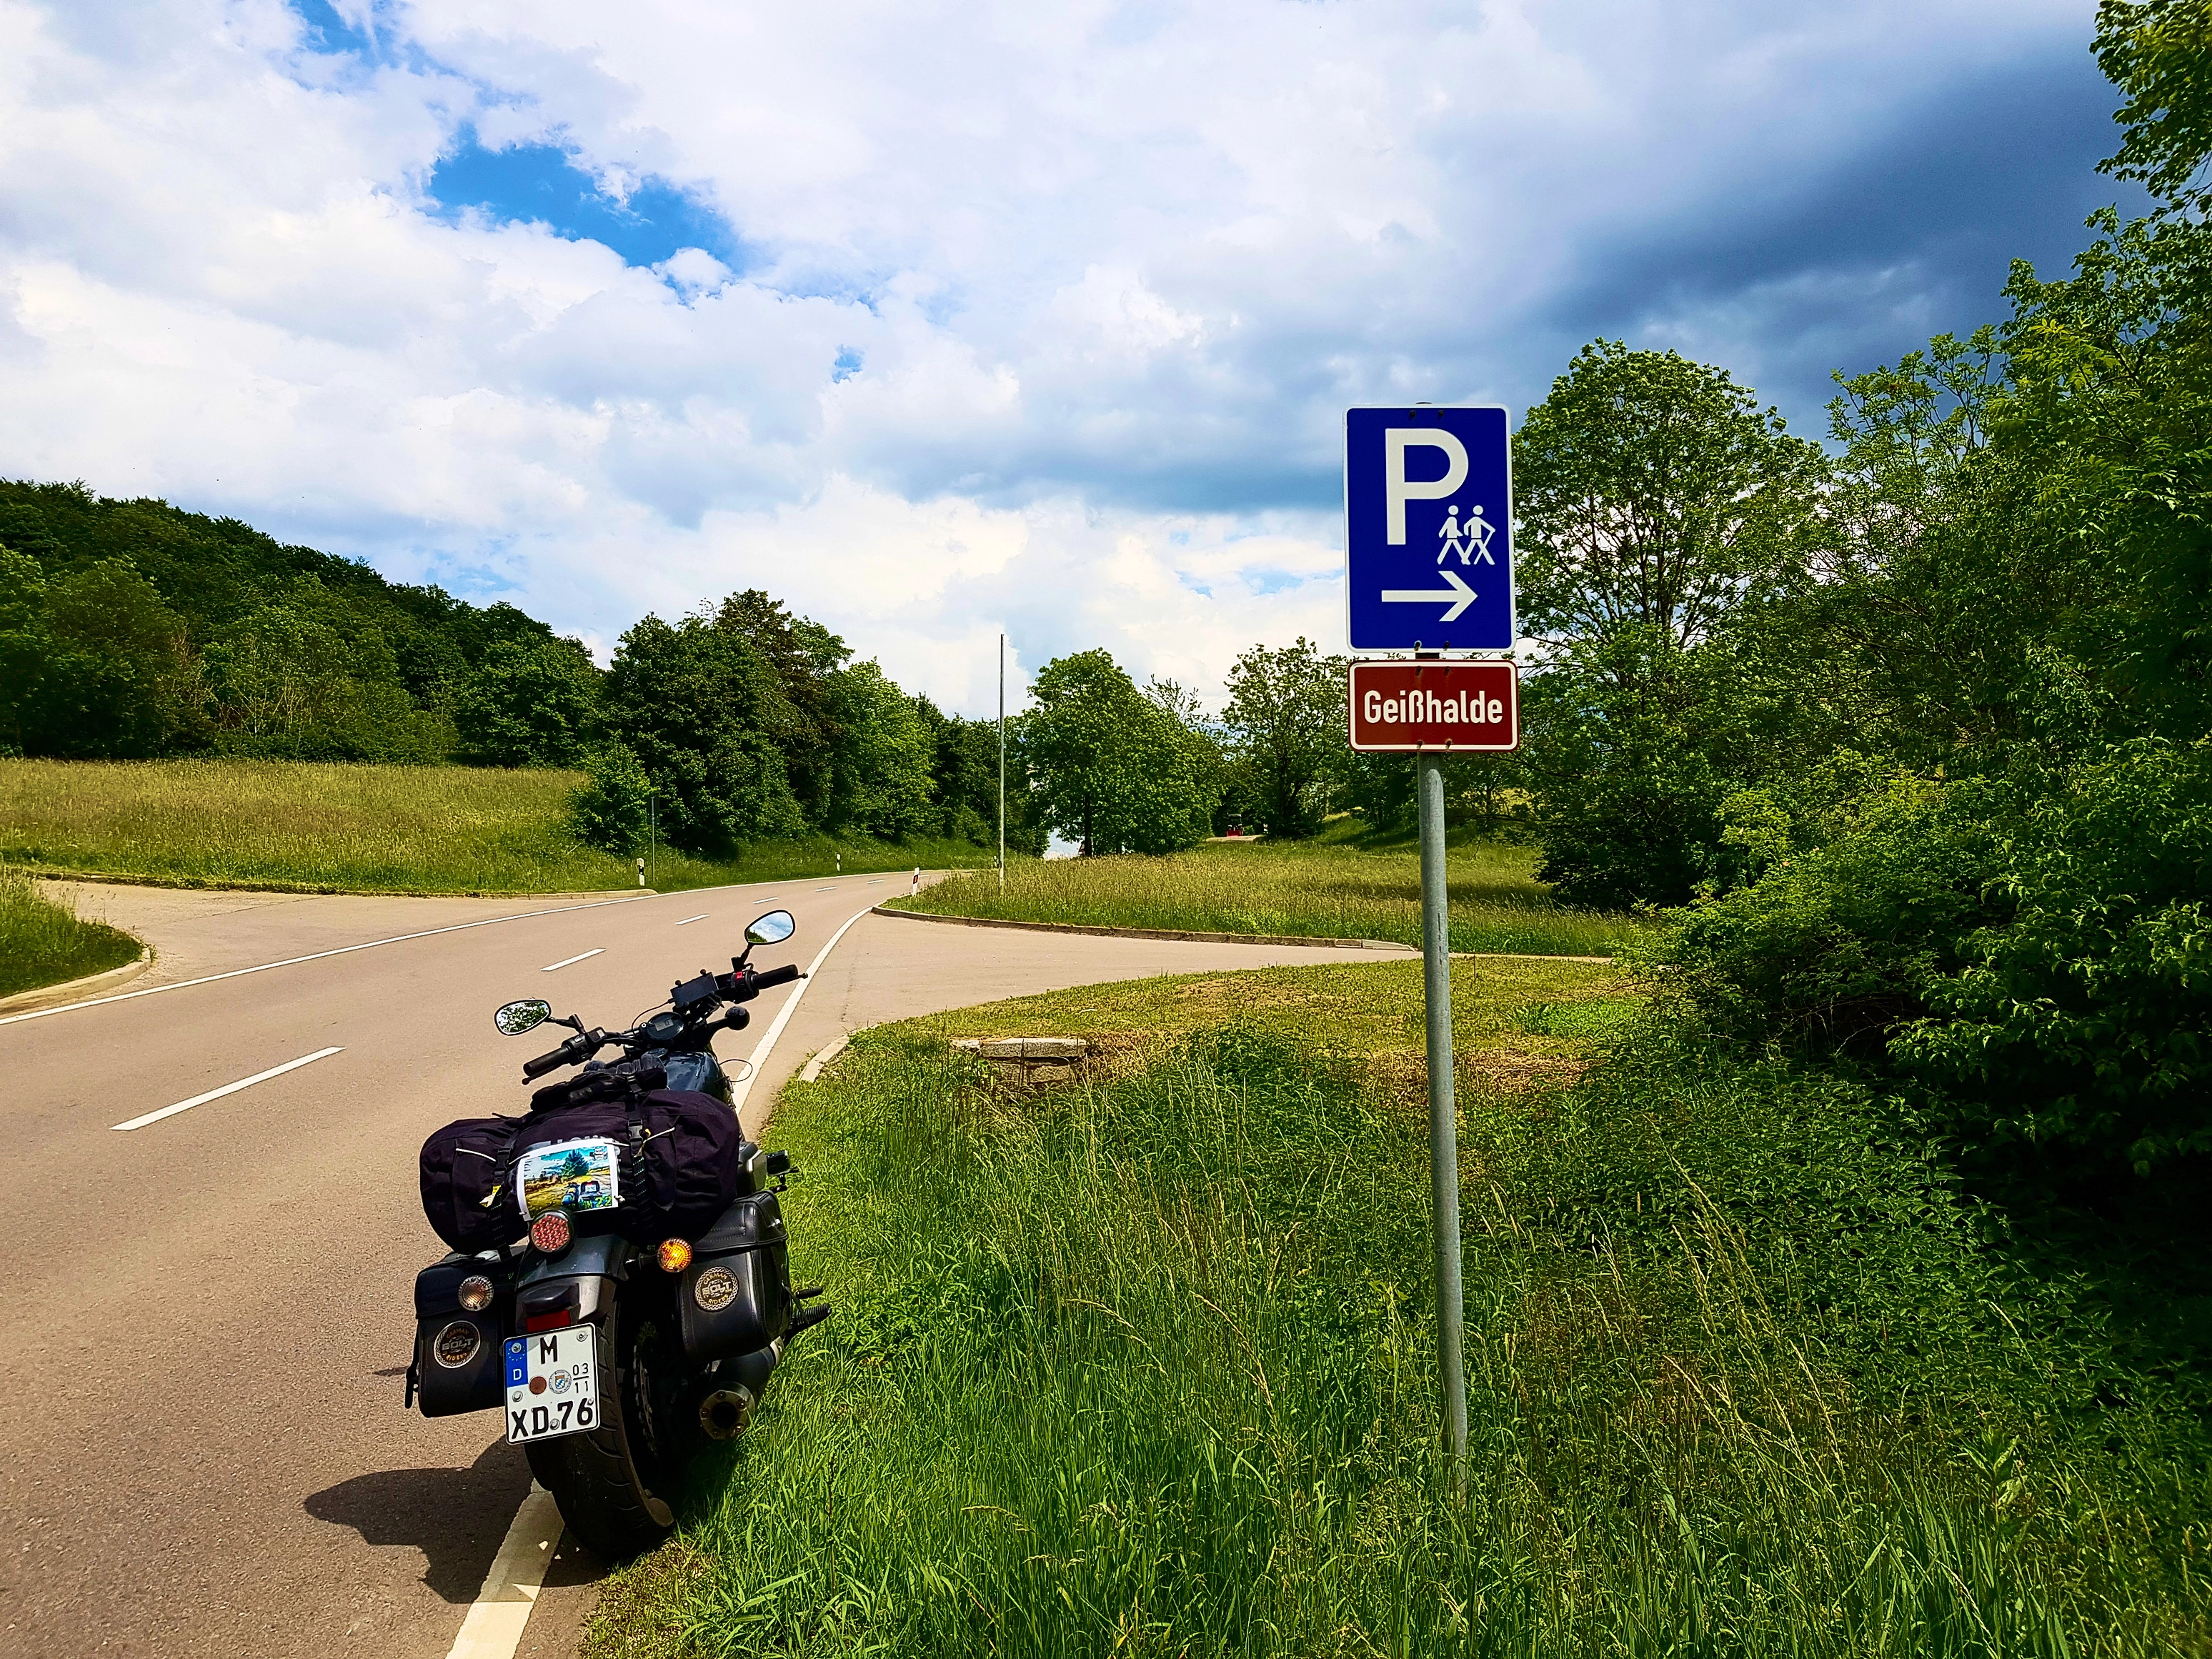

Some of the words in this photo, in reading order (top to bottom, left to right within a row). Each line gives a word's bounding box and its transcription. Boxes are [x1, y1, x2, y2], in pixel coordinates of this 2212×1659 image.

[1385, 428, 1469, 545] P
[1364, 689, 1503, 724] Geißhalde
[702, 1281, 732, 1295] BOLT
[442, 1337, 474, 1351] BOLT
[539, 1335, 558, 1365] M
[513, 1368, 522, 1381] D
[572, 1362, 589, 1376] 03
[574, 1380, 588, 1394] 11
